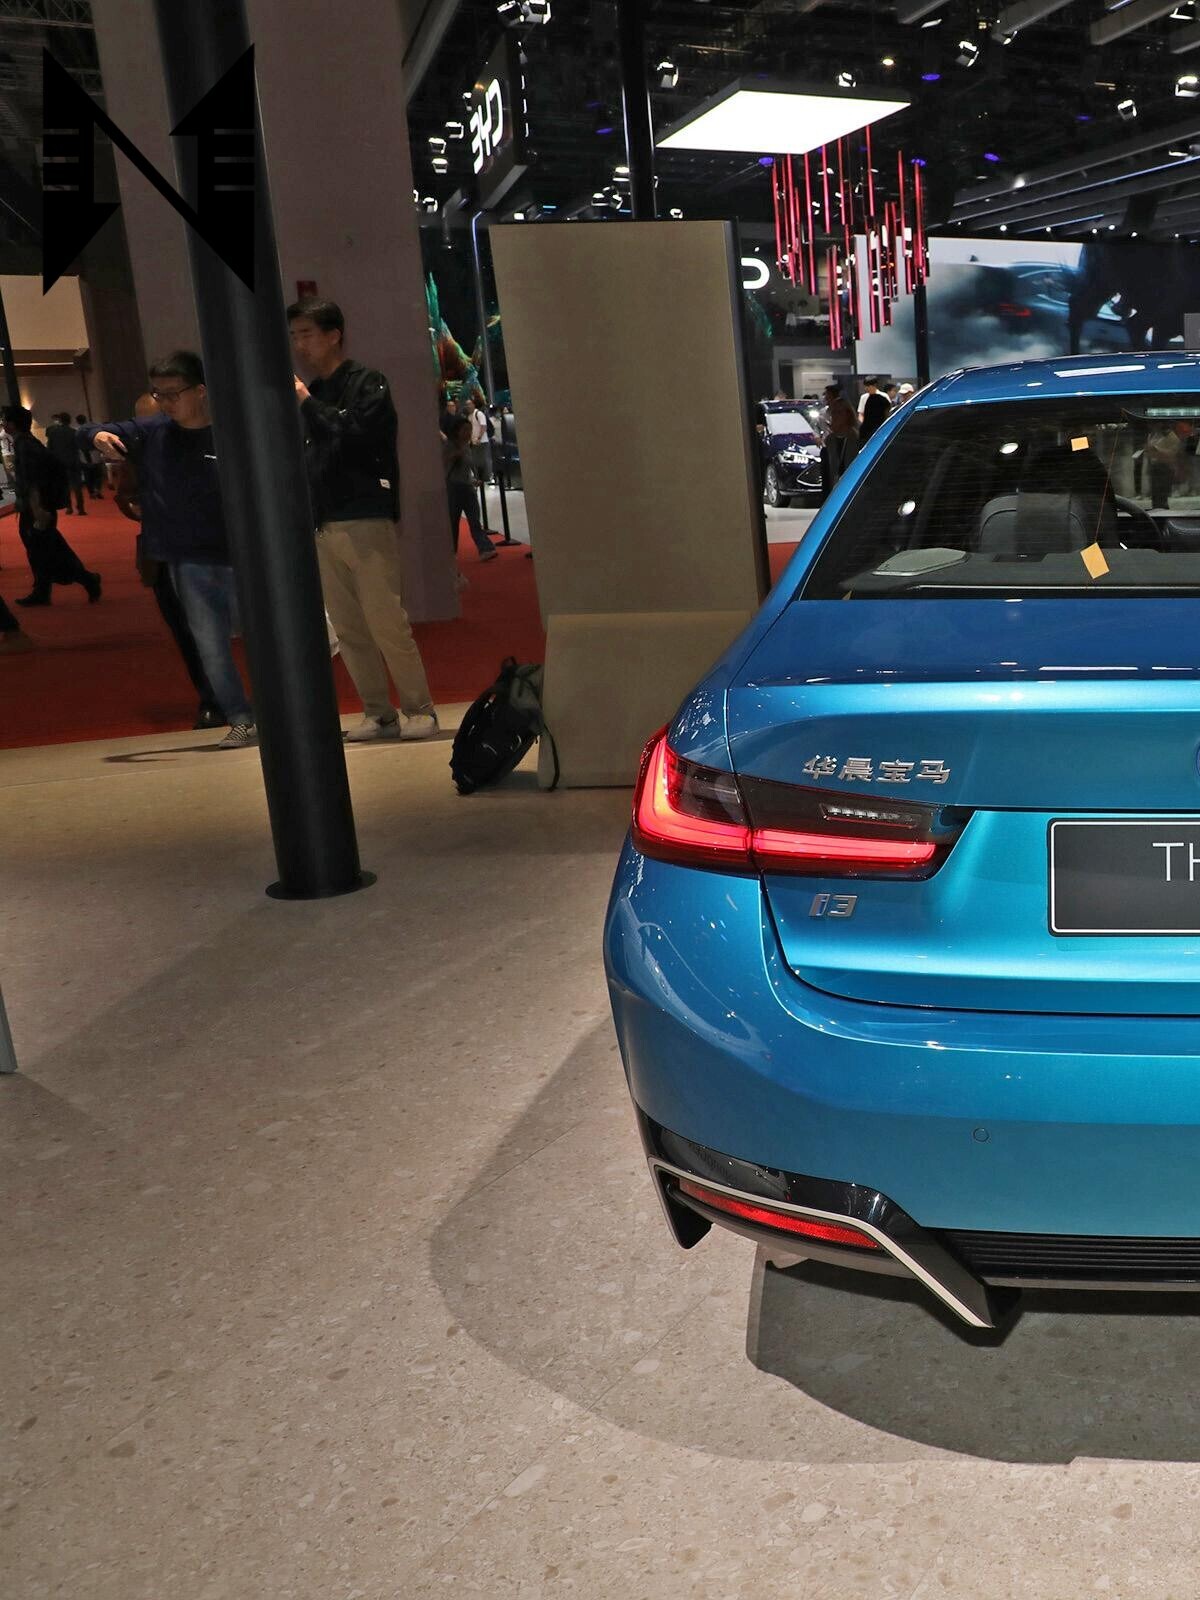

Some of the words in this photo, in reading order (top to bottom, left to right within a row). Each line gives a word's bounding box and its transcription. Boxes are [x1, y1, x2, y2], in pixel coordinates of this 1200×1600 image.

[801, 755, 951, 785] 华晨宝马
[808, 893, 858, 917] i3
